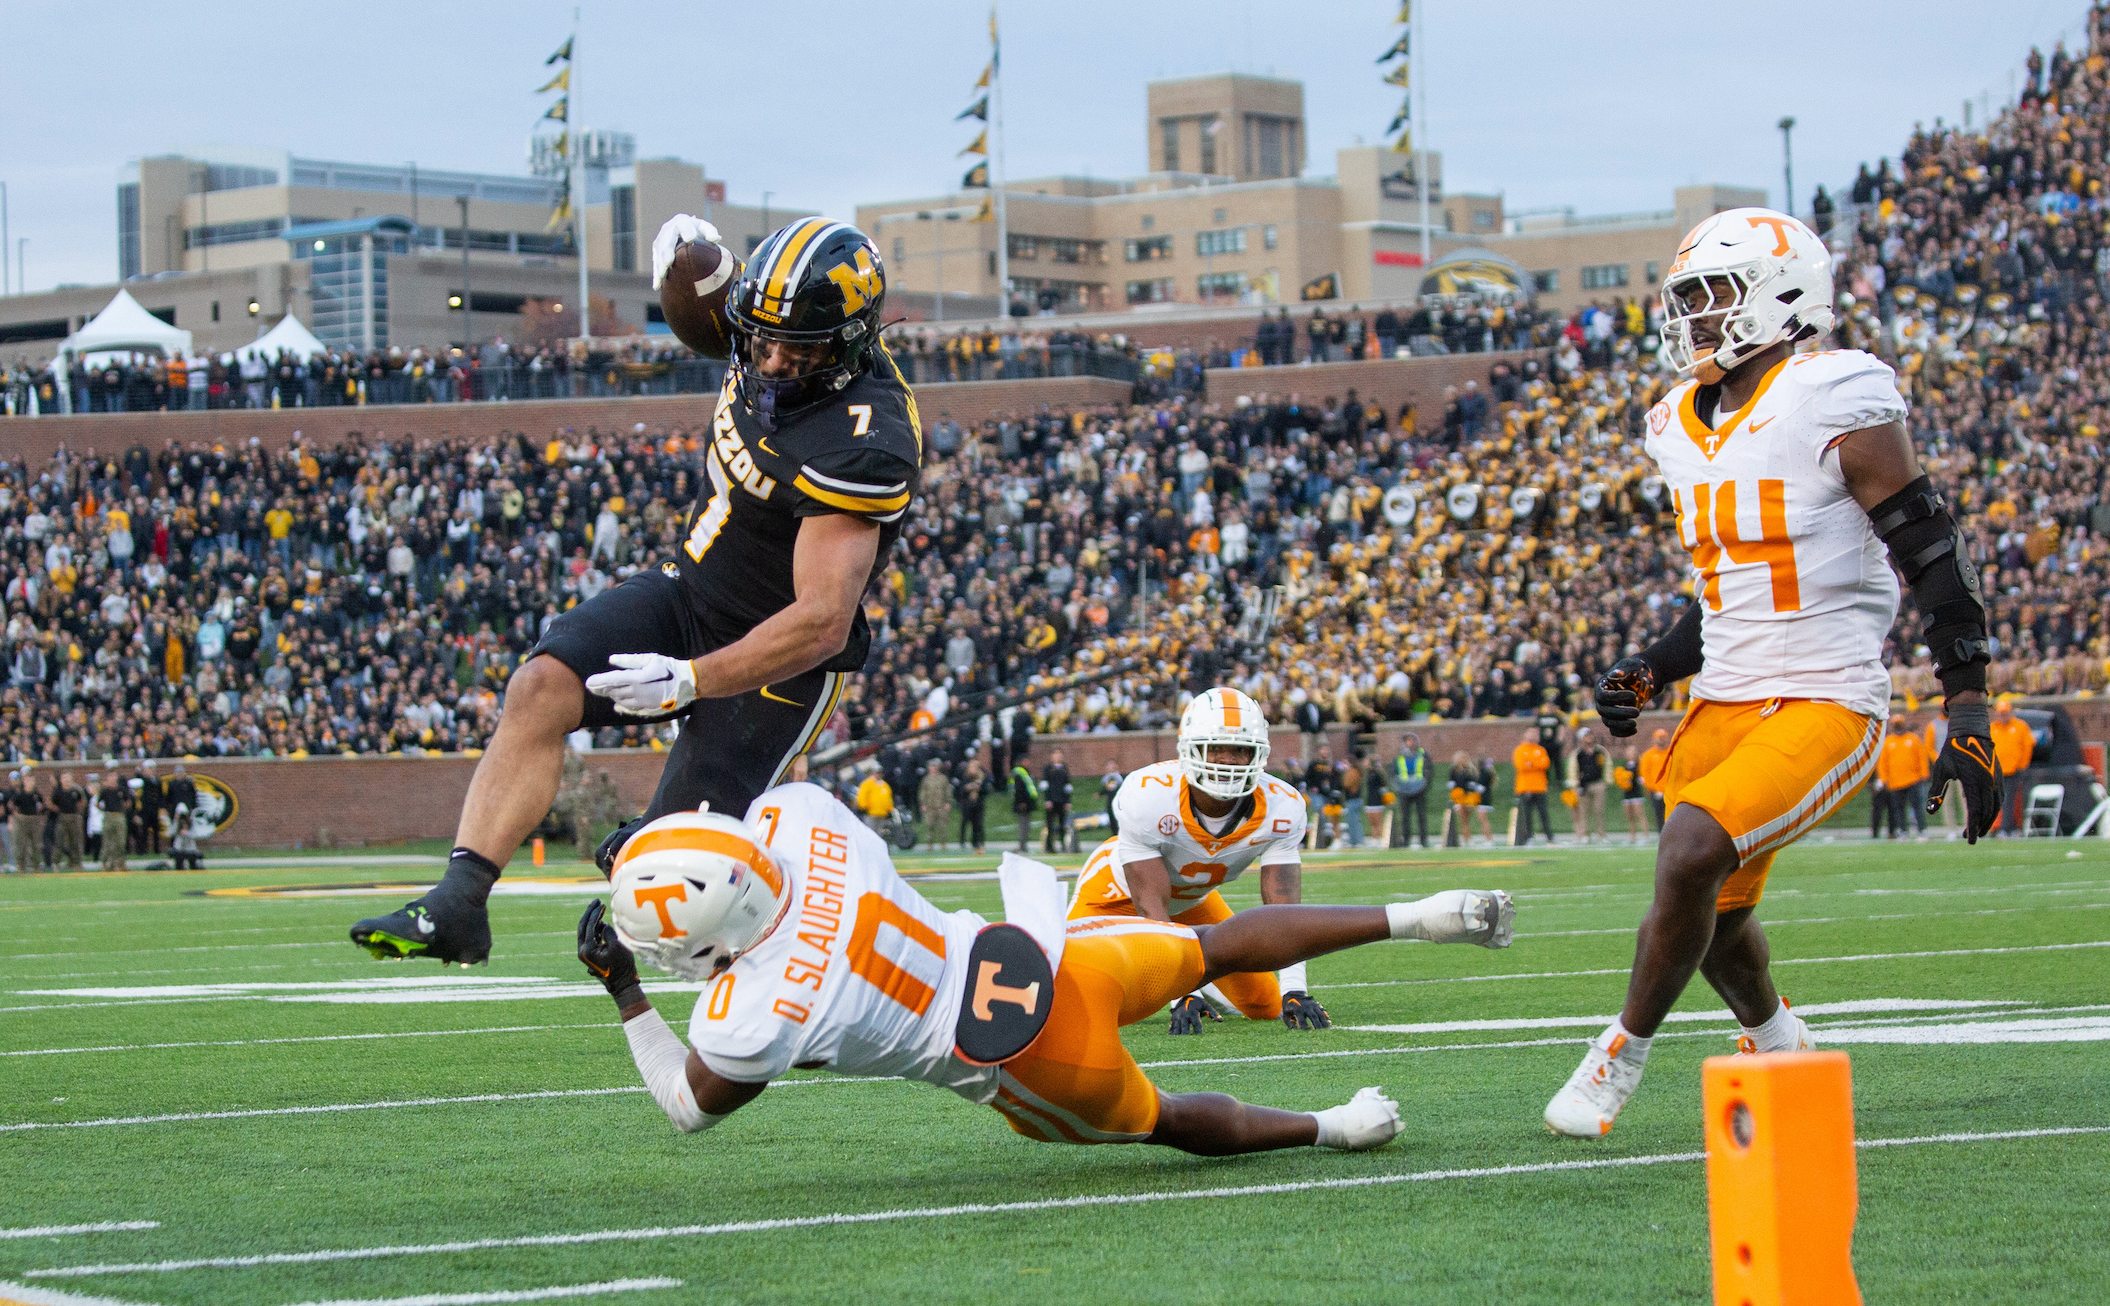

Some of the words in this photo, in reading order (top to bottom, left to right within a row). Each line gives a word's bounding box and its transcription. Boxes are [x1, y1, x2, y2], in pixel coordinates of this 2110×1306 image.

[1745, 217, 1799, 258] T
[827, 247, 884, 318] M
[751, 308, 783, 324] MIZZOU
[848, 404, 873, 437] 7
[1705, 434, 1720, 455] T
[1141, 774, 1174, 788] 2
[1269, 782, 1299, 801] 2
[1272, 819, 1291, 834] C
[1209, 841, 1222, 852] T
[1170, 861, 1229, 900] 2
[634, 883, 689, 940] T
[784, 826, 848, 993] SLAUGHTER
[846, 891, 947, 1018] 0
[707, 972, 737, 1021] 0
[972, 960, 1040, 1022] T
[772, 999, 815, 1025] D.
